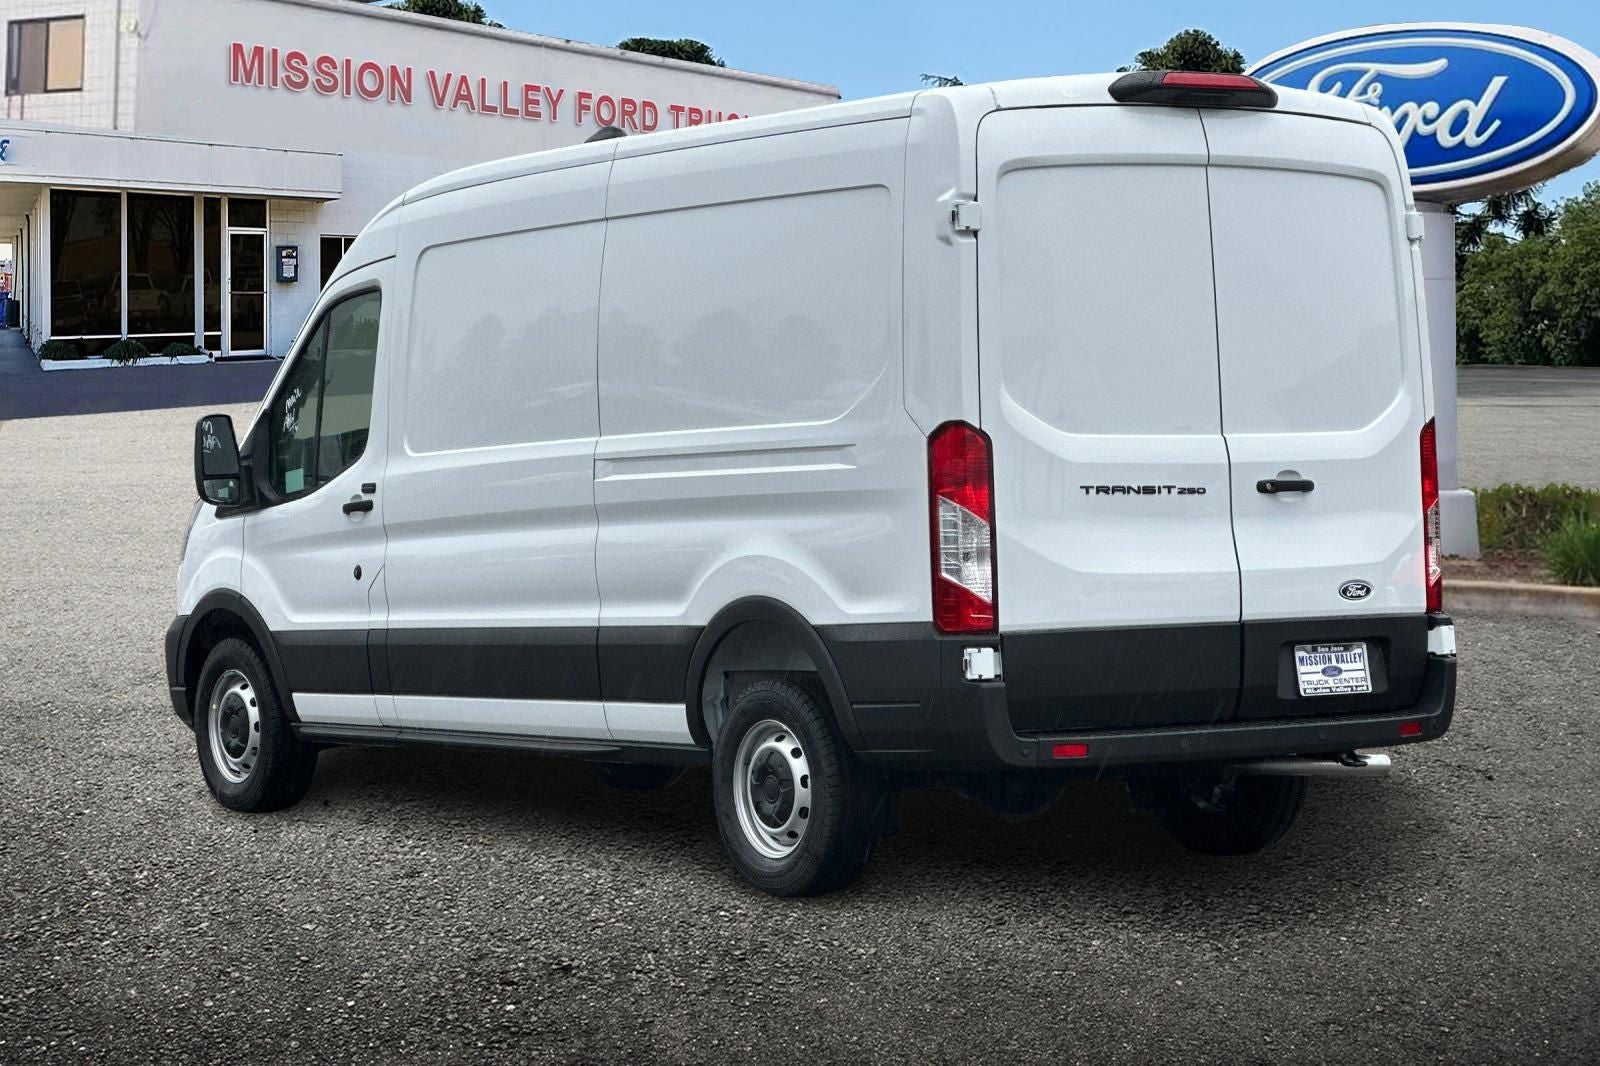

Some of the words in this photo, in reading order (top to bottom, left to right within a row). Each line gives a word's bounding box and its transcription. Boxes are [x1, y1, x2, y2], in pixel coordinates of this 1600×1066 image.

[230, 42, 413, 104] MISSION
[427, 69, 565, 122] VALLEY
[576, 91, 659, 133] FORD
[1307, 57, 1508, 150] Frd
[1079, 485, 1177, 495] TRANSIT
[1177, 487, 1207, 495] 250
[1298, 653, 1333, 667] MISSION
[1335, 652, 1363, 665] VALLEY
[1301, 679, 1330, 687] TRUCK
[1332, 676, 1367, 685] CENTER
